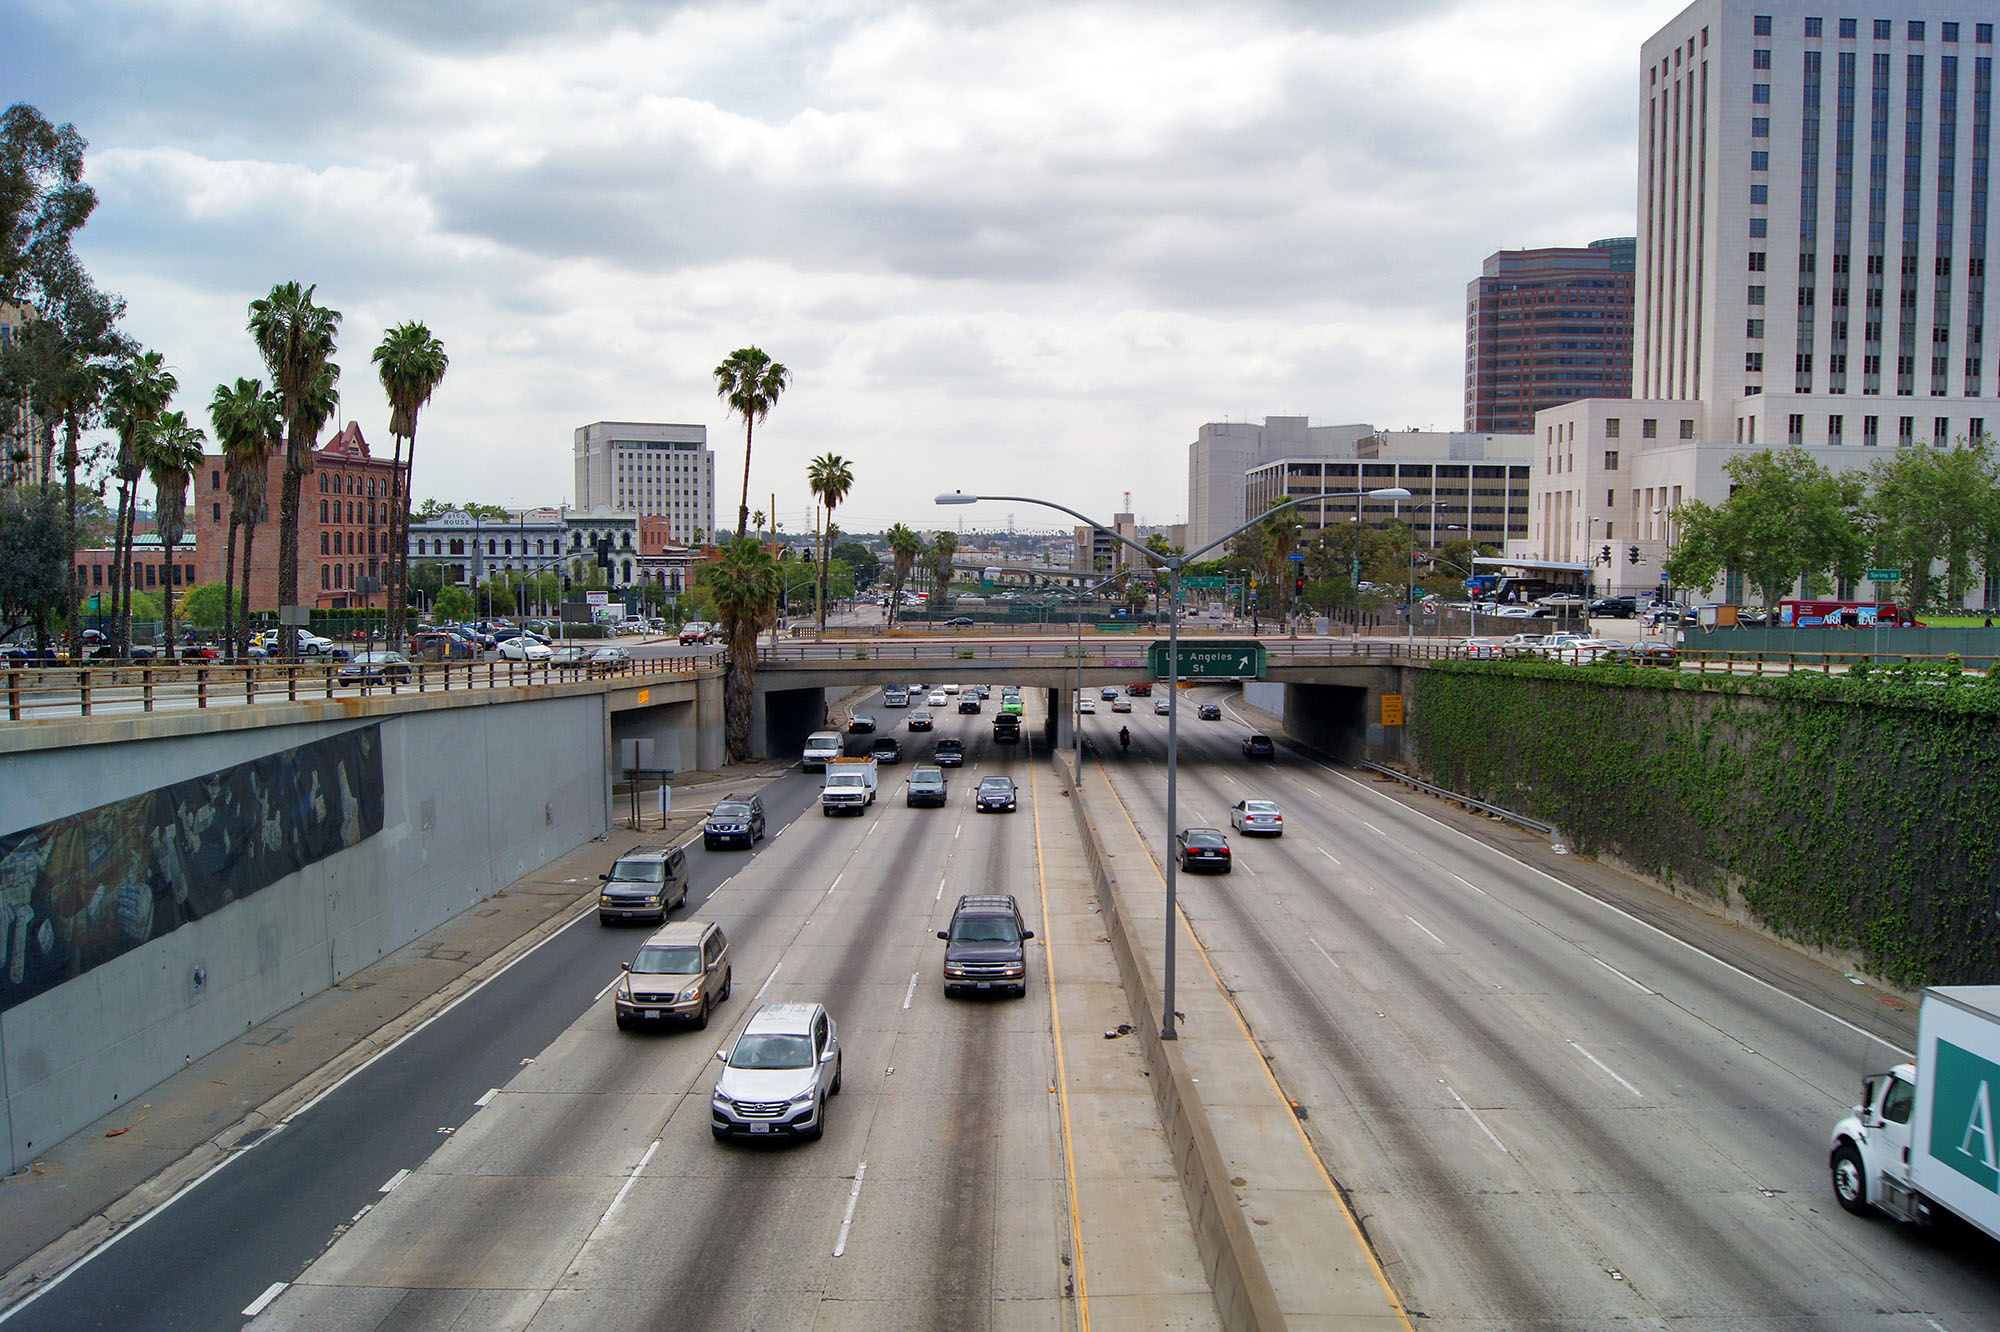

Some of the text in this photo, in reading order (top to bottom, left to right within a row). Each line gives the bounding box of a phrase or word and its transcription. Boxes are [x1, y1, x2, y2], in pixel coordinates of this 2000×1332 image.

[1165, 652, 1232, 662] Ls Angeles
[1192, 664, 1204, 672] St
